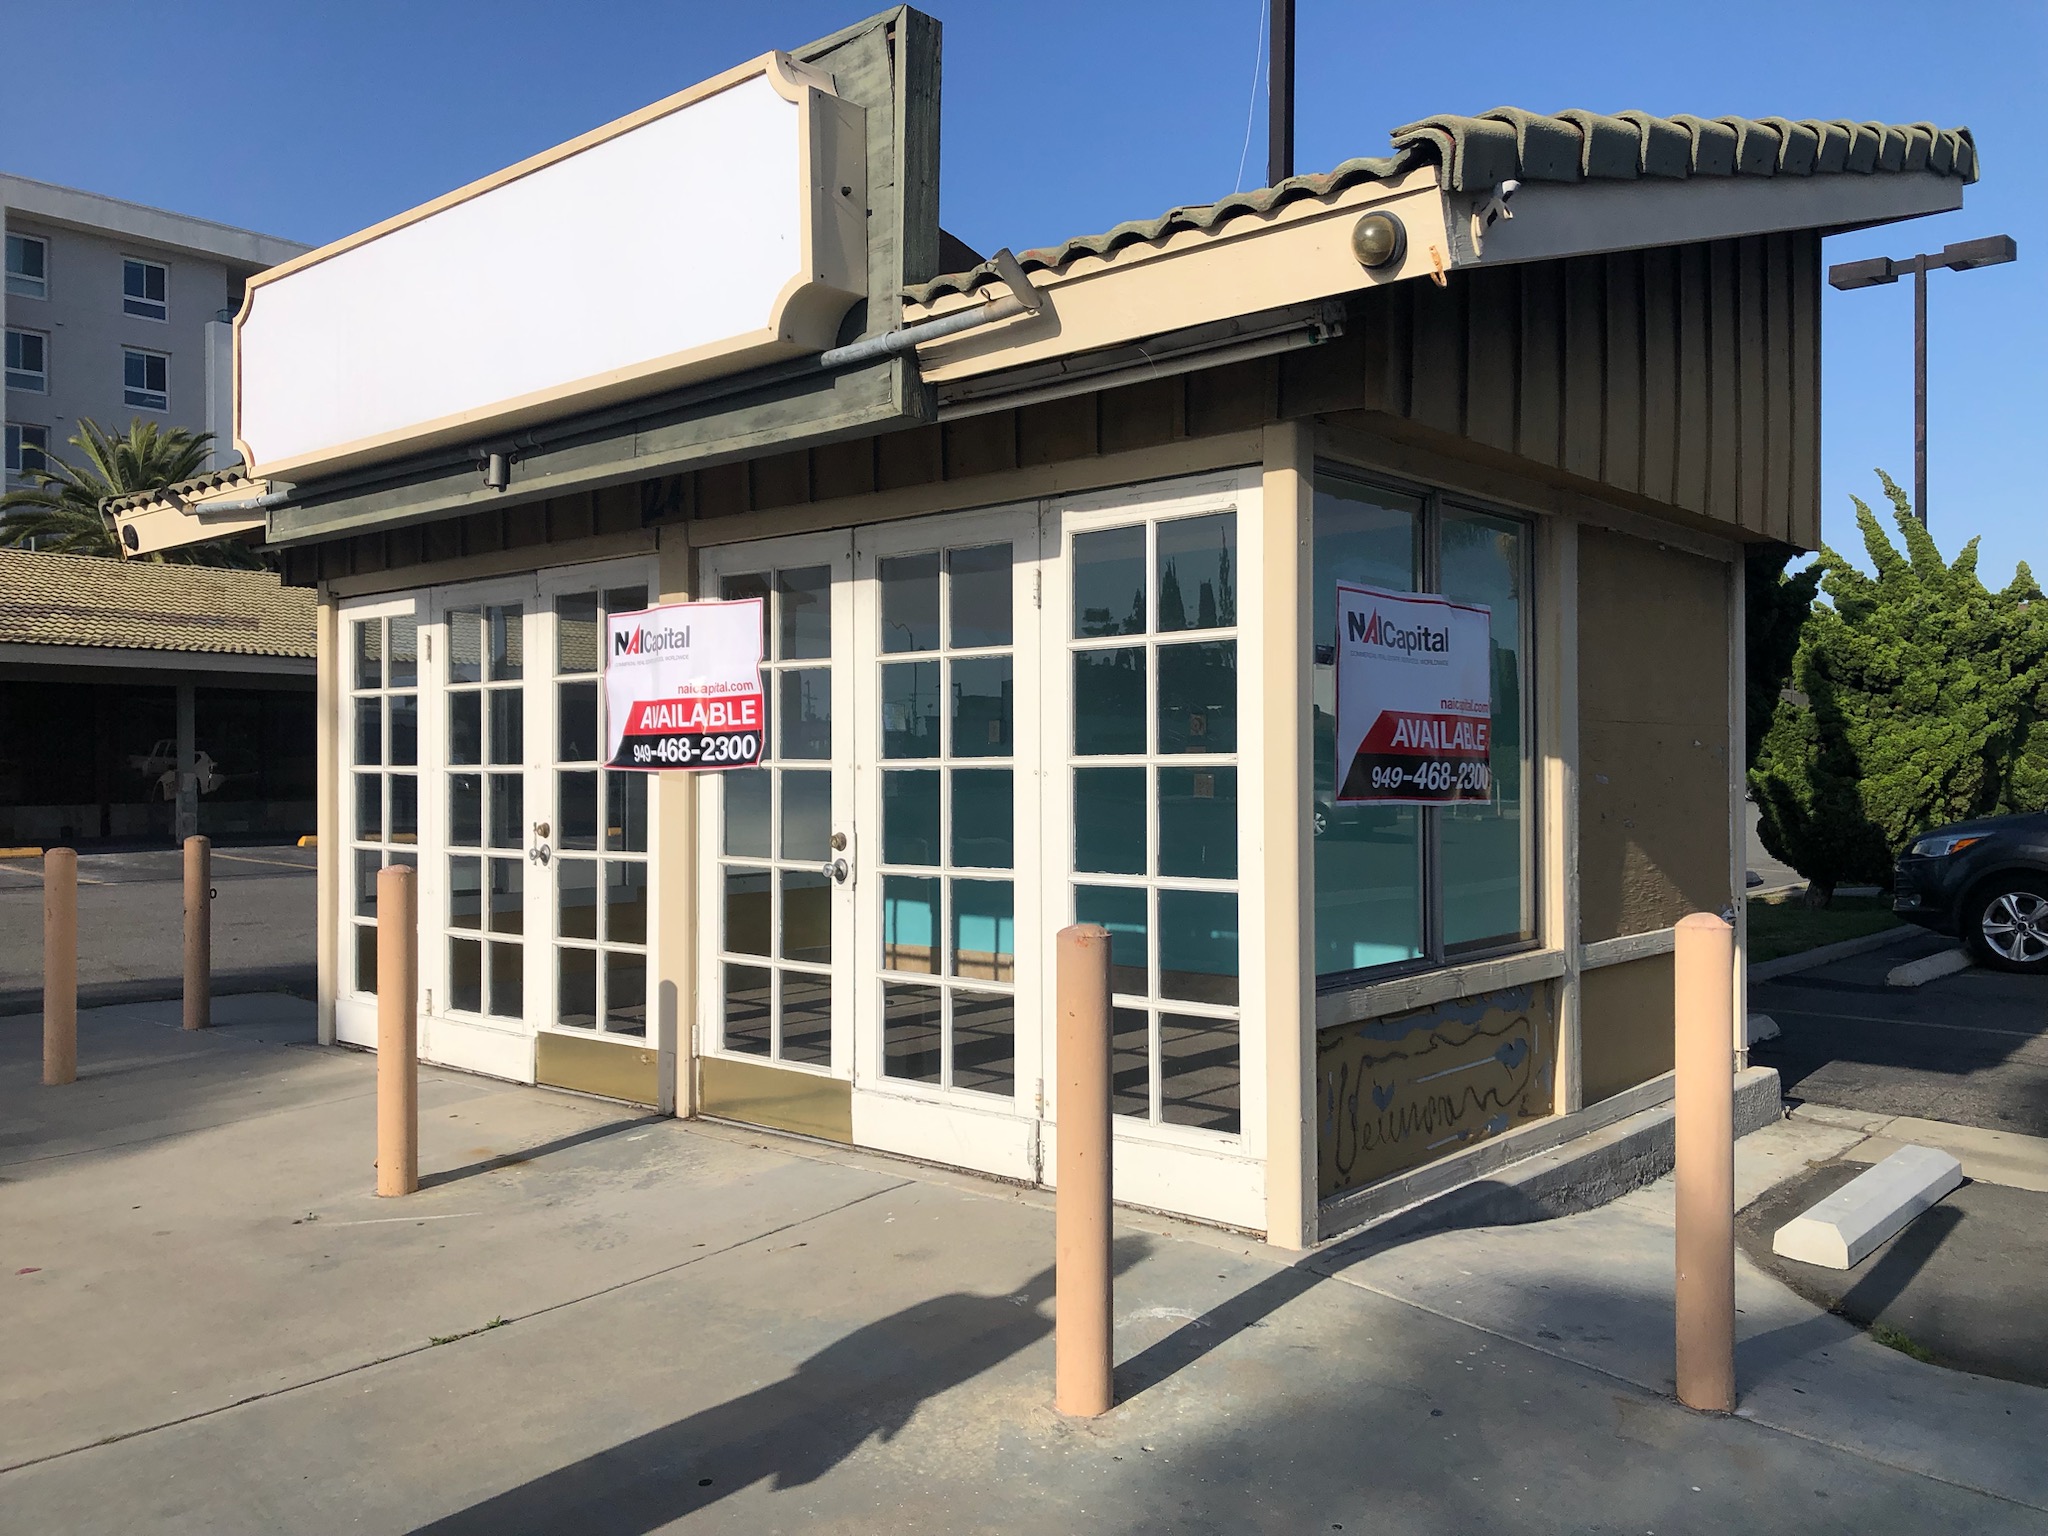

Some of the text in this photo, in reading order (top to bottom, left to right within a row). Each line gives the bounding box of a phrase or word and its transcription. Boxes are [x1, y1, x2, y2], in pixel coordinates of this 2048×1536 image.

[678, 681, 754, 696] naicapital.com
[639, 699, 756, 730] AVAILABLE
[1441, 697, 1489, 714] naicapital.com
[633, 734, 756, 763] 949-468-2300
[1391, 720, 1486, 750] AVAILABLE
[1371, 761, 1490, 791] 949-468-2300
